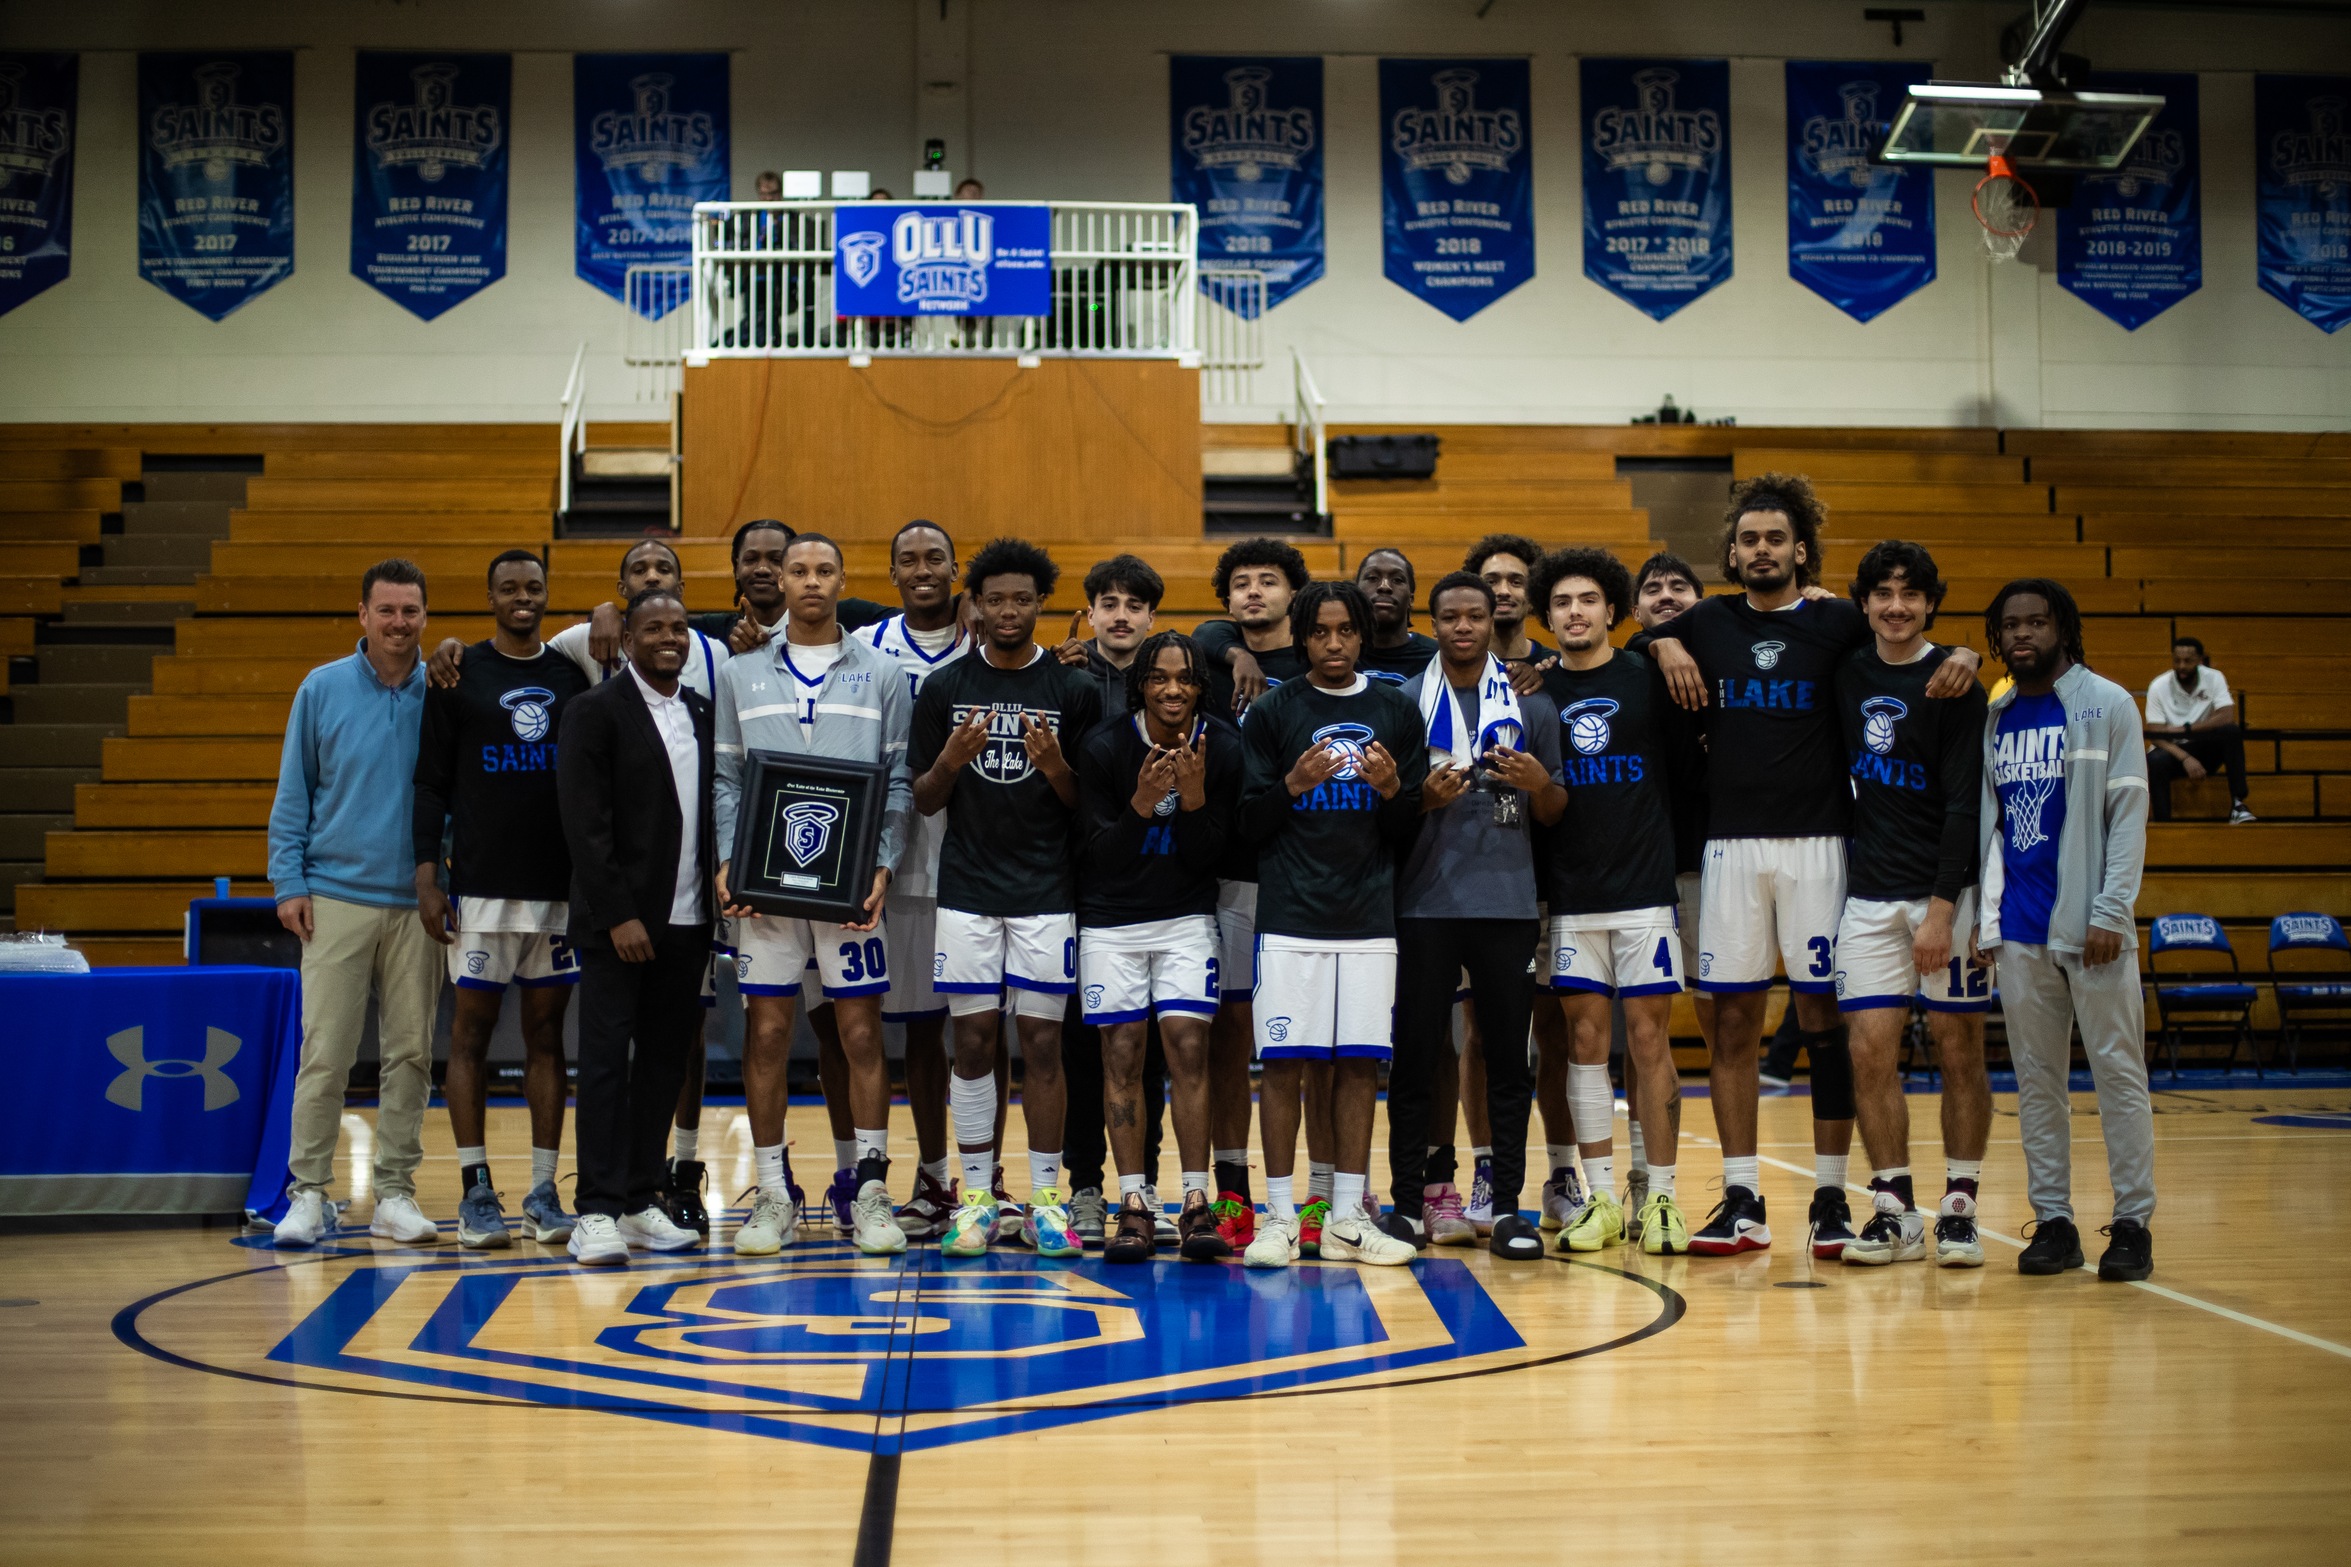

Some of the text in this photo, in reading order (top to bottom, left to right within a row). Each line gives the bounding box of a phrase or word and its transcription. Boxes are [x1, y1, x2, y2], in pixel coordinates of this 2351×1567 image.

[153, 106, 283, 146] SAINTS
[369, 105, 496, 145] SAINTS
[594, 114, 711, 149] SAINTS
[1187, 109, 1310, 147] SAINTS
[1398, 112, 1517, 149] SAINTS
[1597, 112, 1716, 149] SAINTS
[1806, 122, 1880, 154] SAIN
[175, 196, 259, 213] RED RIVER
[389, 196, 474, 213] RED RIVER
[612, 194, 645, 208] RED
[1207, 198, 1291, 214] RED RIVER
[1416, 199, 1500, 216] RED RIVER
[1617, 199, 1699, 216] RED RIVER
[1823, 198, 1903, 214] RED RIVER
[2091, 207, 2168, 223] RED RIVER
[194, 234, 238, 252] 2017
[407, 234, 452, 252] 2017
[894, 210, 991, 266] OLLU
[1225, 235, 1272, 253] 2018
[1435, 237, 1482, 255] 2018
[1605, 236, 1710, 254] 2017 2018
[2086, 240, 2172, 257] 2018-2019
[2310, 244, 2349, 259] 2018
[899, 266, 987, 300] SAINTS
[1425, 275, 1494, 287] CHAMPIONS
[843, 672, 873, 684] LAKE
[1726, 678, 1816, 710] LAKE
[991, 702, 1023, 713] OLLU
[2075, 707, 2104, 721] LAKE
[482, 743, 559, 773] SAINT
[984, 749, 1024, 770] The Lake
[1564, 754, 1644, 787] AINTS
[1994, 759, 2065, 787] BASKETBAL
[2160, 920, 2214, 938] SAINTS
[2283, 917, 2332, 933] SAINTS
[839, 937, 887, 982] 30
[1063, 937, 1075, 978] 0
[1652, 937, 1673, 978] 4
[1807, 935, 1837, 978] 3
[1205, 957, 1220, 999] 2
[1947, 955, 1988, 998] 12
